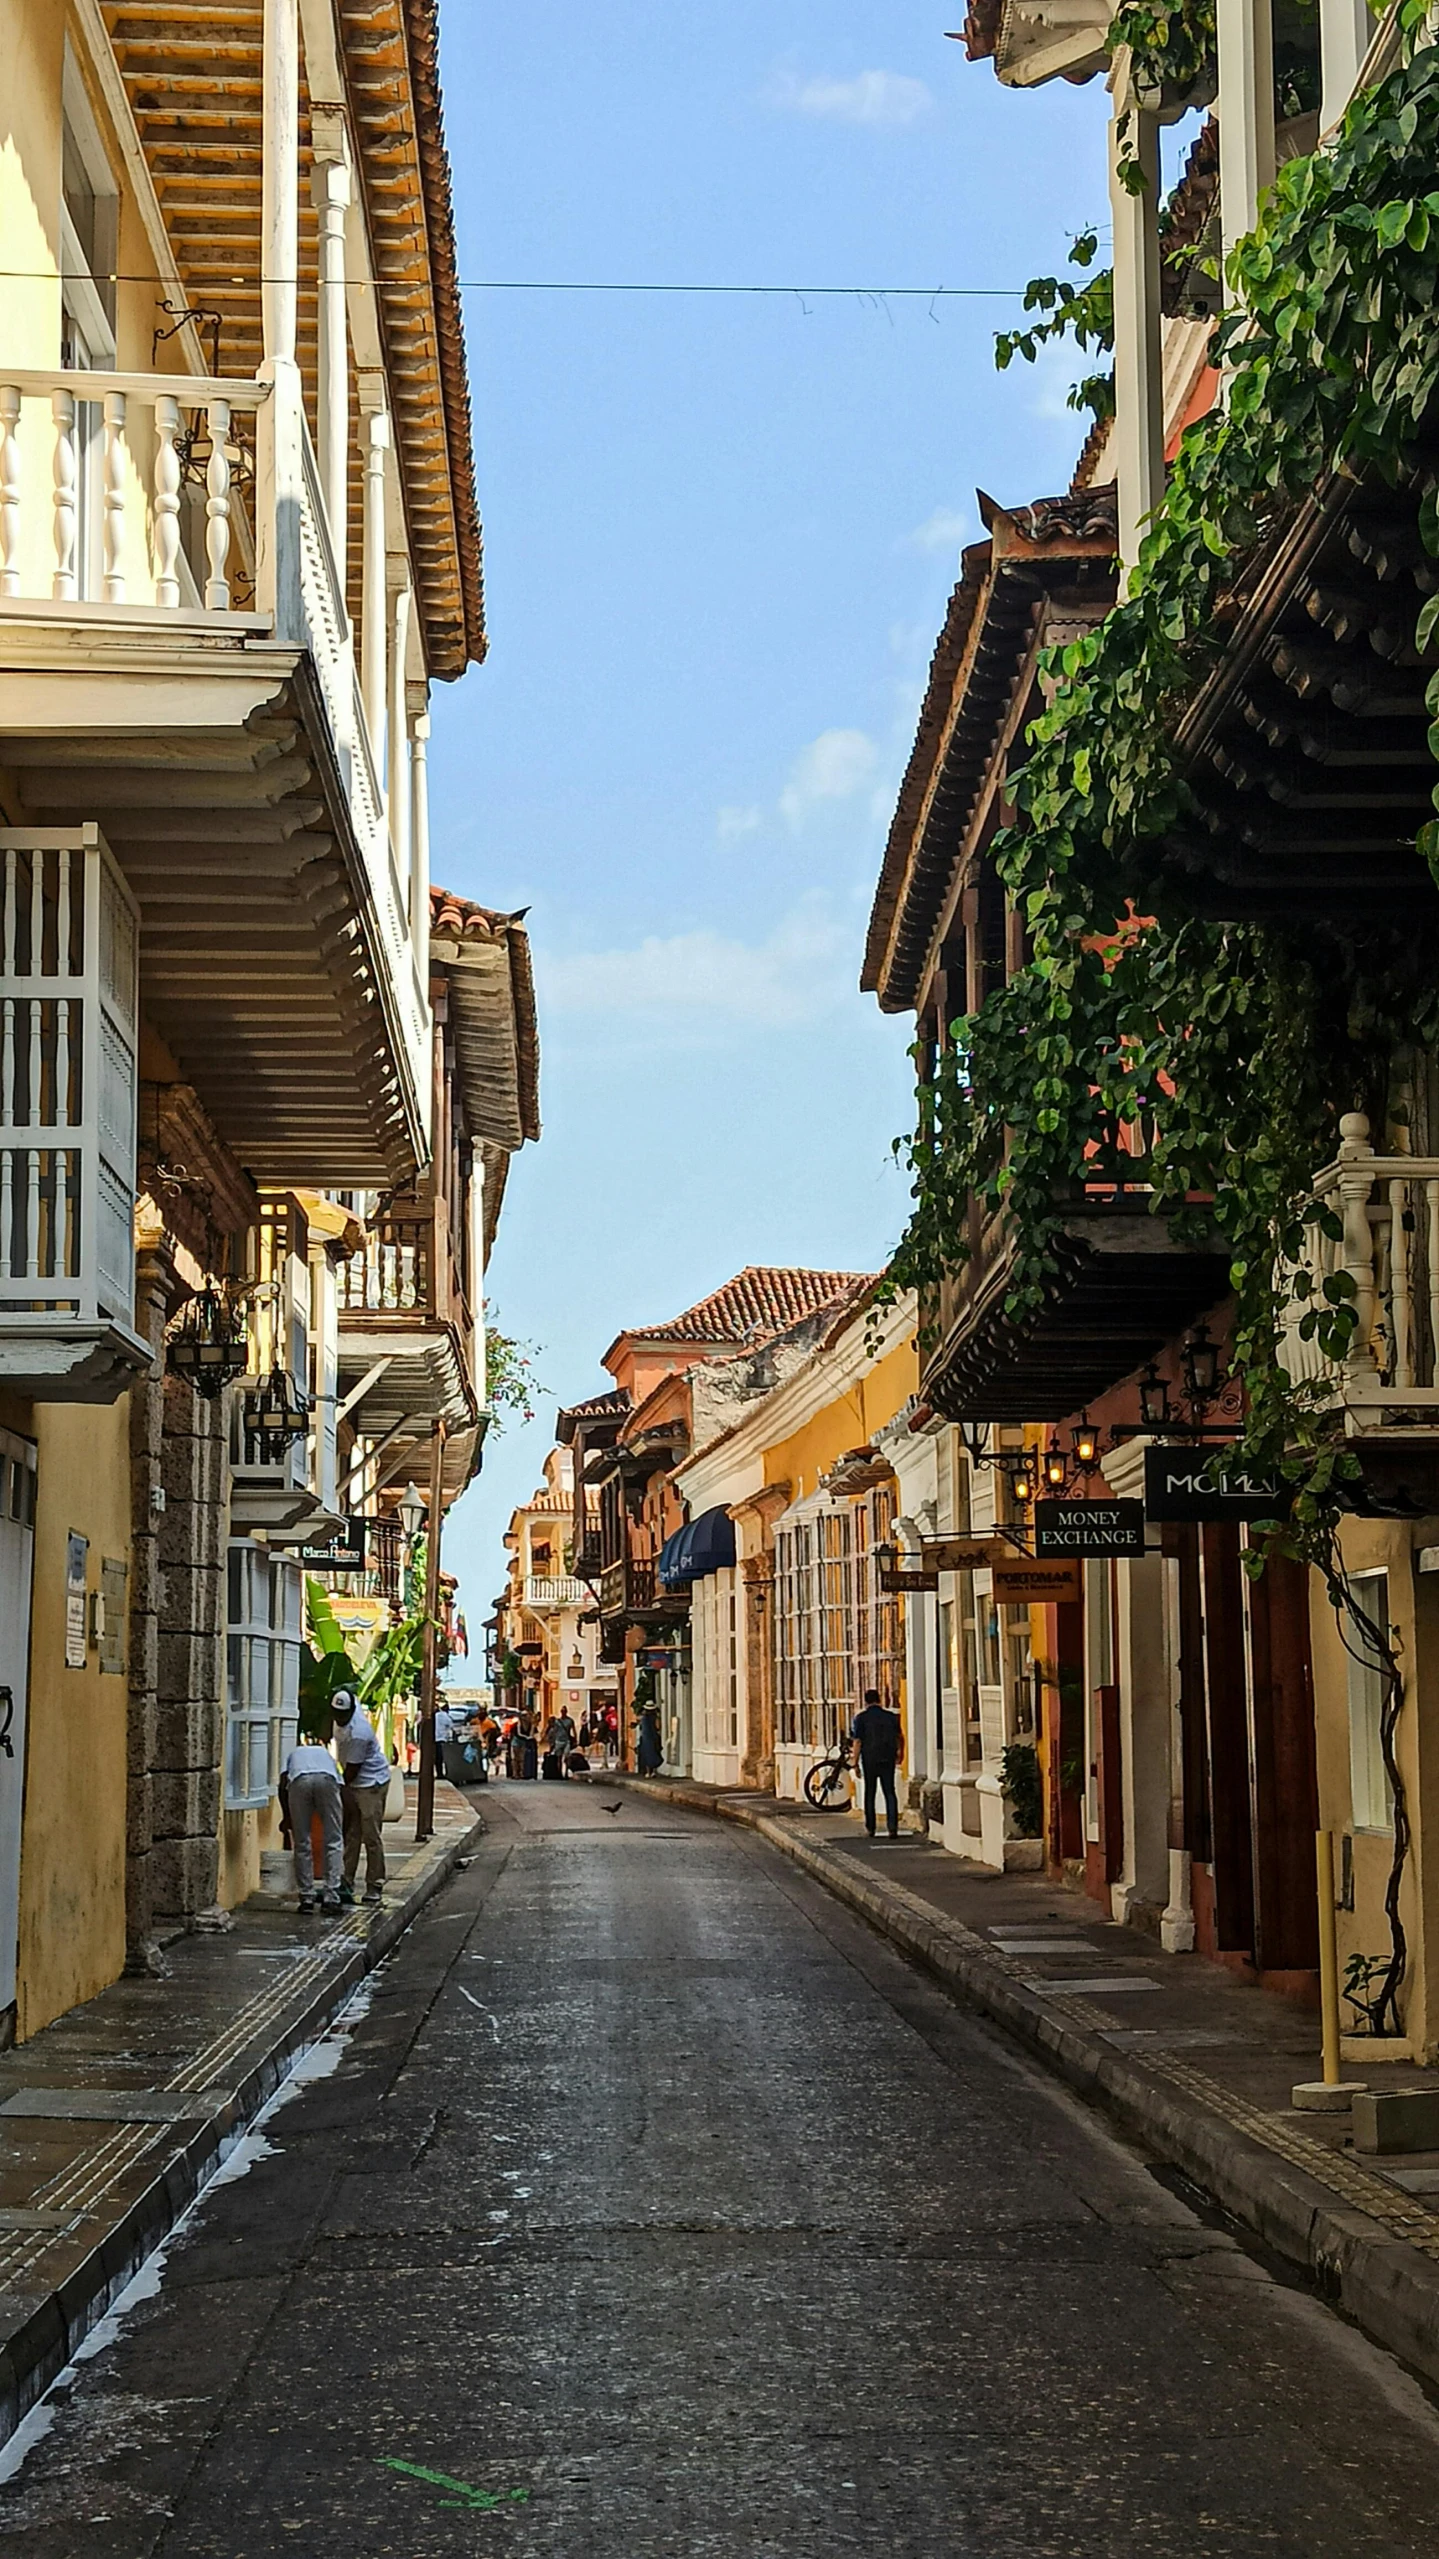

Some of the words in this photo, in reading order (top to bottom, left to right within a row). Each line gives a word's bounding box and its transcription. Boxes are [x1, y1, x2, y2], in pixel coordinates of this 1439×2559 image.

[1058, 1512, 1121, 1526] MONEY
[1041, 1529, 1137, 1545] EXCHANGE
[996, 1571, 1073, 1584] PORTOMAR
